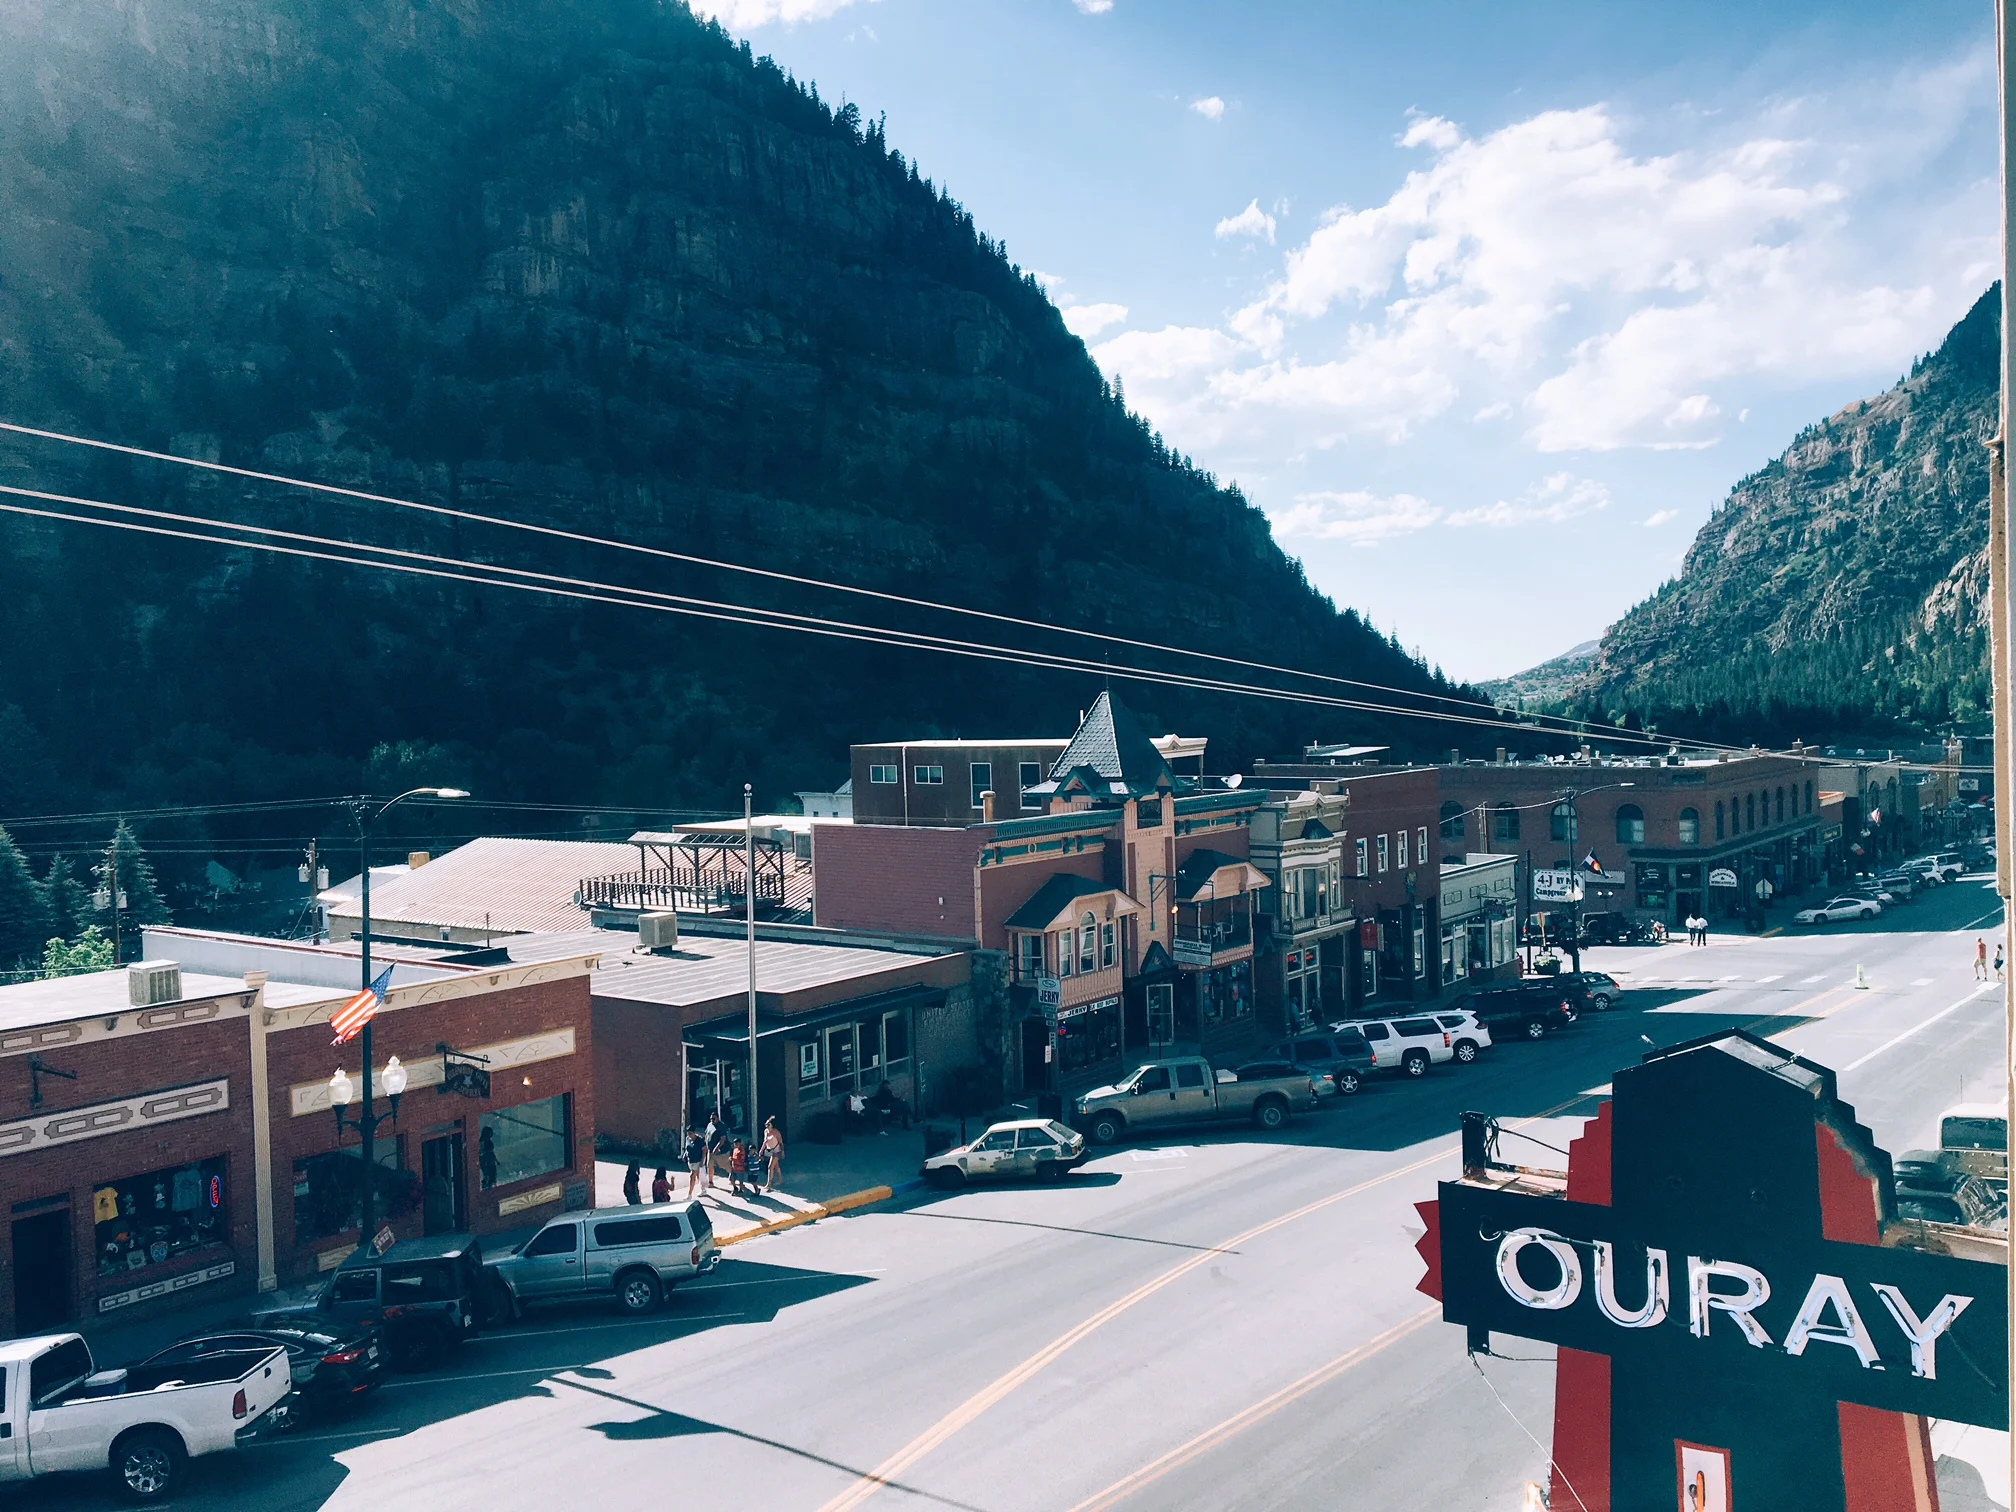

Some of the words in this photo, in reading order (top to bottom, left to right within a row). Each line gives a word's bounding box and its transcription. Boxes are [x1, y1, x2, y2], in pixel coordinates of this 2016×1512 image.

[1538, 874, 1553, 887] 4-J
[1039, 989, 1060, 1004] JERKY
[1067, 1006, 1087, 1017] JERKY
[1494, 1226, 1974, 1380] OURAY
